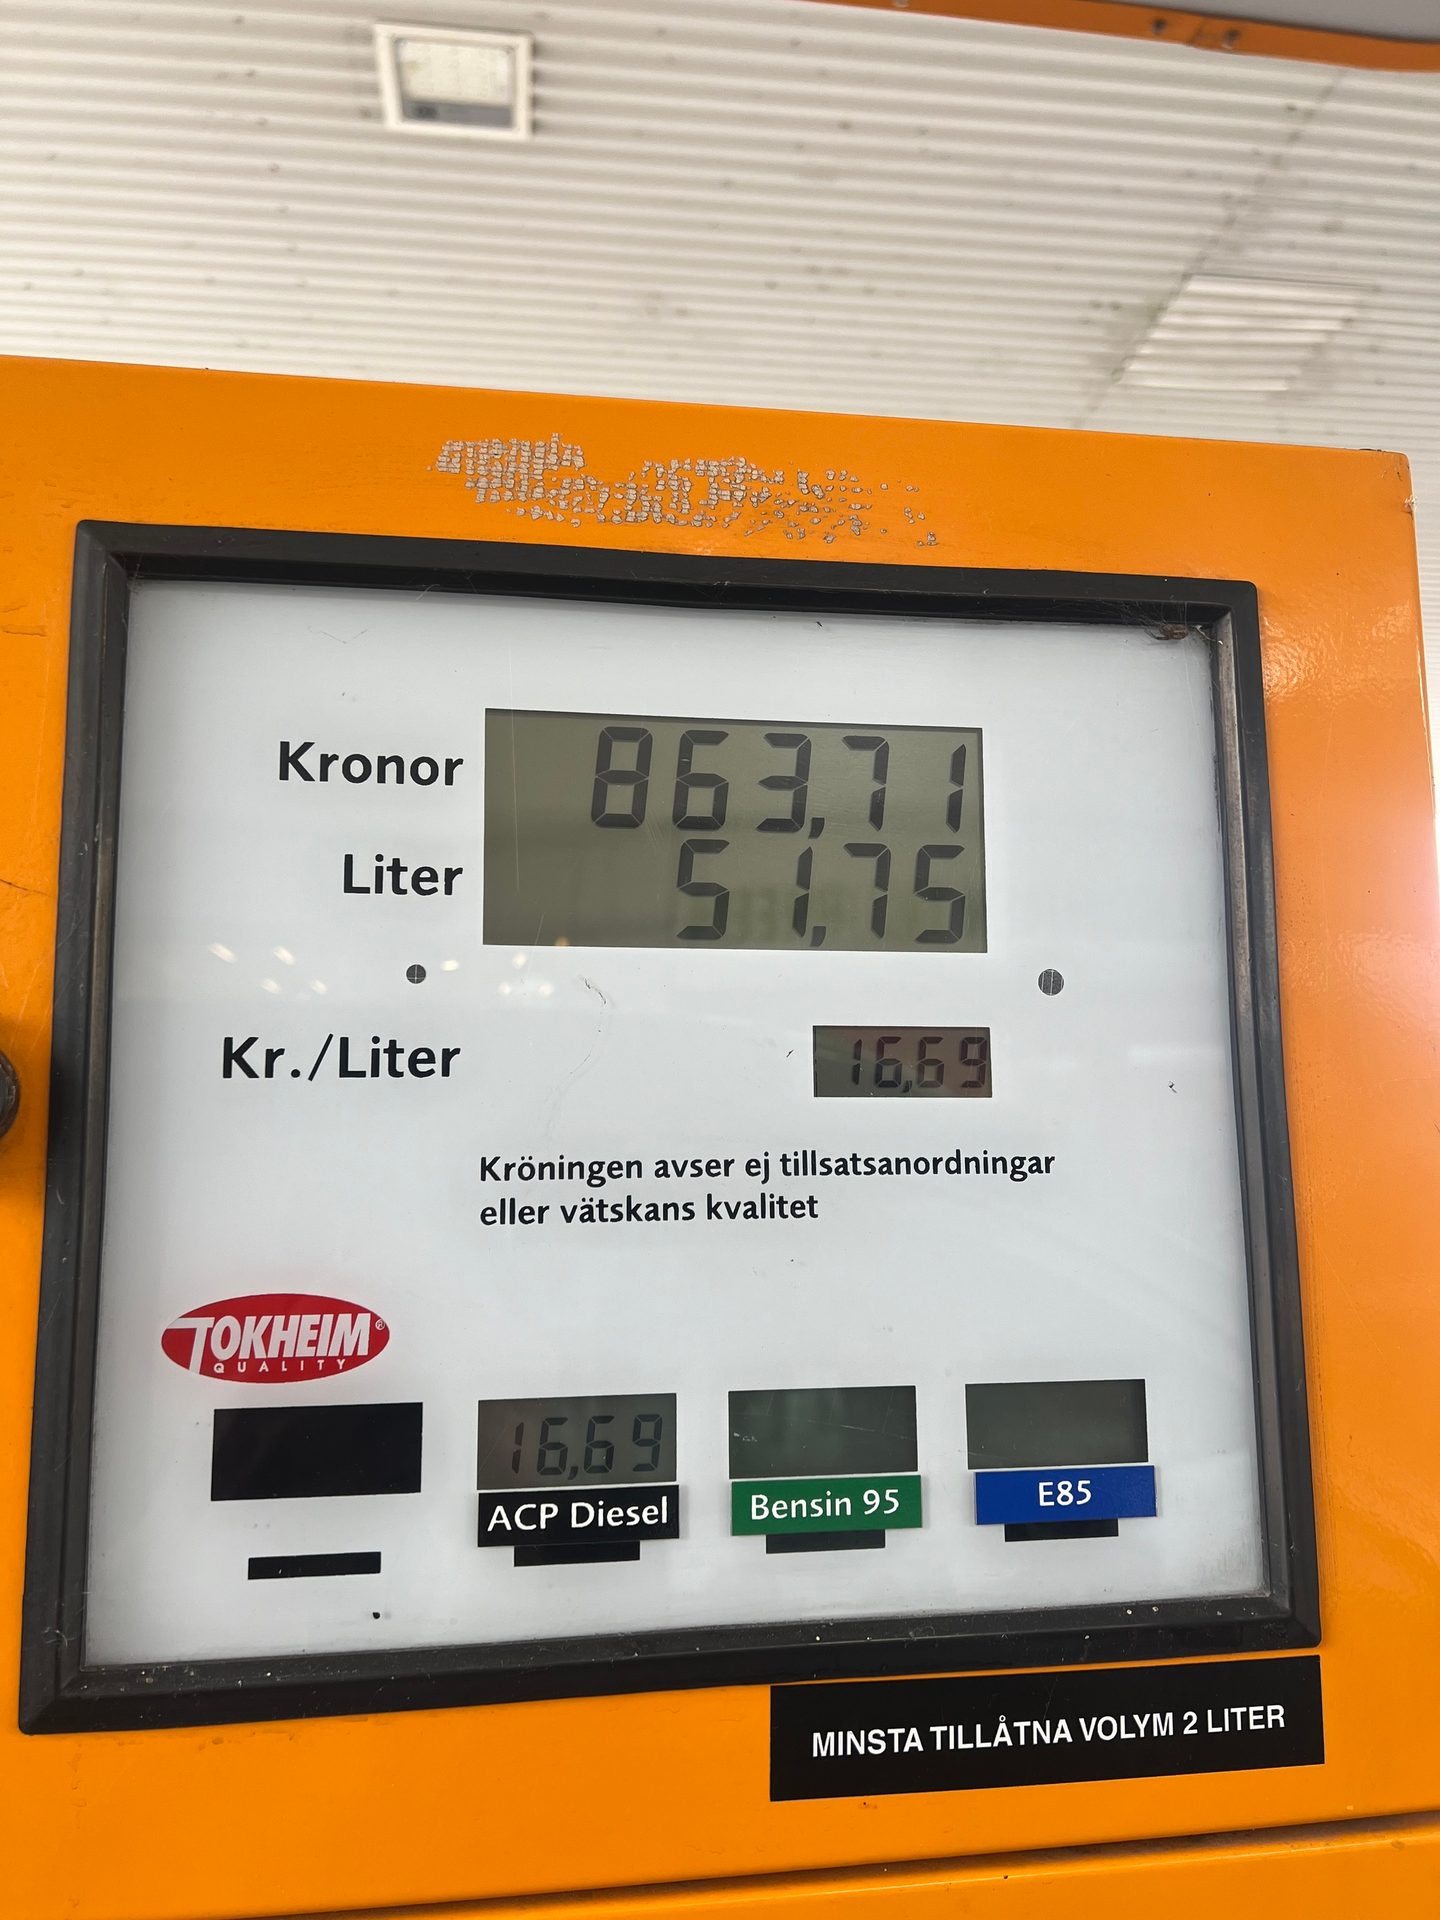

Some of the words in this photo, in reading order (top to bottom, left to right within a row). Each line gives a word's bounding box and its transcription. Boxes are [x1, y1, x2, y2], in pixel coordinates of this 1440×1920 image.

[279, 740, 464, 786] Kronor
[591, 726, 967, 839] 863,71
[343, 854, 463, 895] Liter
[676, 838, 966, 946] 51,75
[223, 1033, 461, 1082] Kr./Liter
[852, 1036, 988, 1093] 16,69
[480, 1155, 643, 1187] Kröningen
[654, 1156, 735, 1180] avser
[745, 1153, 770, 1184] ej
[780, 1149, 1056, 1181] tillsatsanordningar
[480, 1199, 549, 1225] eller
[560, 1198, 696, 1223] vätskans
[706, 1193, 819, 1220] kvalitet
[164, 1313, 372, 1373] TOKHEIM
[213, 1359, 347, 1374] QUALITY
[511, 1413, 664, 1480] 16,69
[487, 1504, 558, 1532] ACP
[571, 1496, 669, 1529] Diesel
[751, 1491, 852, 1521] Bensin
[863, 1488, 901, 1515] 95
[1038, 1480, 1093, 1507] E85
[812, 1728, 924, 1758] MINSTA
[930, 1715, 1073, 1751] TILLÅTNA
[1079, 1711, 1174, 1741] VOLYM
[1182, 1711, 1198, 1735] 2
[1206, 1704, 1286, 1733] LITER
